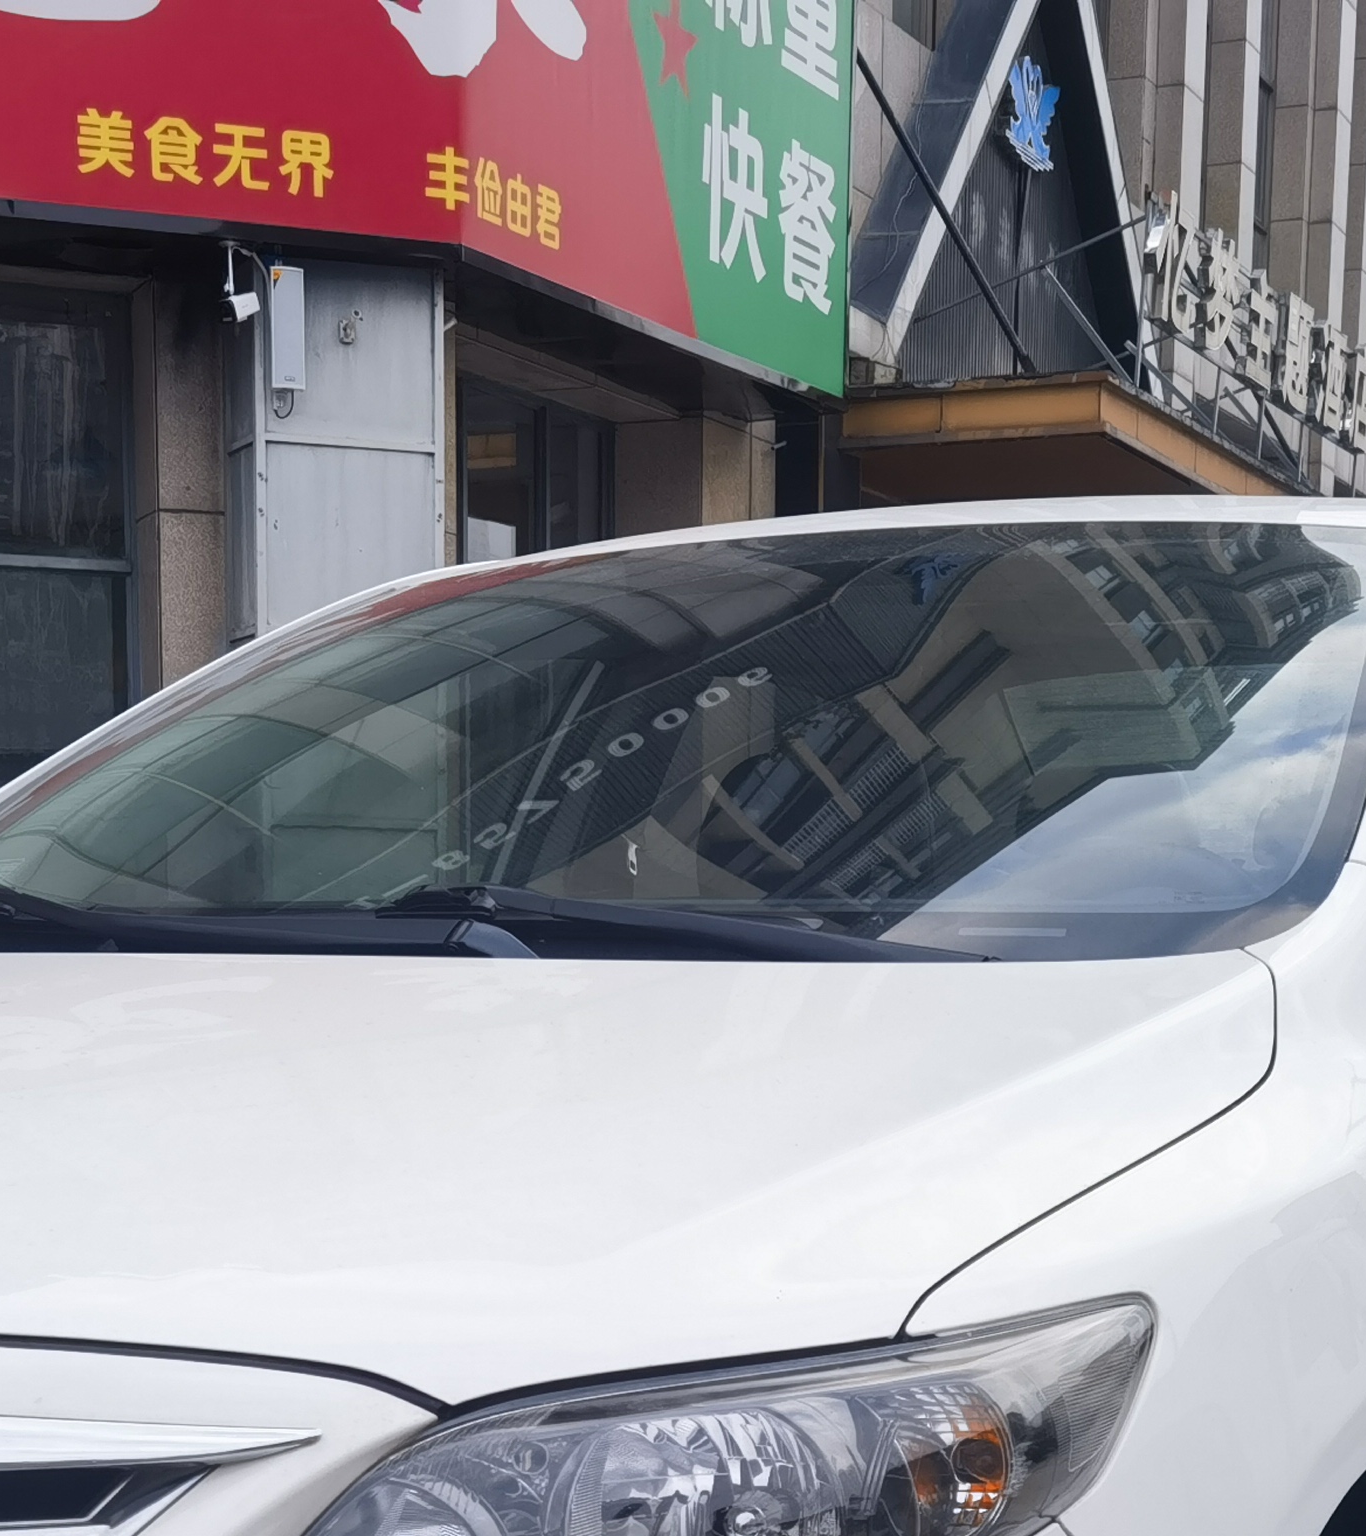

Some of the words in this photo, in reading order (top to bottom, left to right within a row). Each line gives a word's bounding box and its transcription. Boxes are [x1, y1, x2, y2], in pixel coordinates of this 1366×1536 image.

[704, 0, 840, 101] 重
[76, 107, 334, 198] 美食无界
[424, 147, 563, 251] 丰俭由君
[702, 92, 838, 316] 快餐
